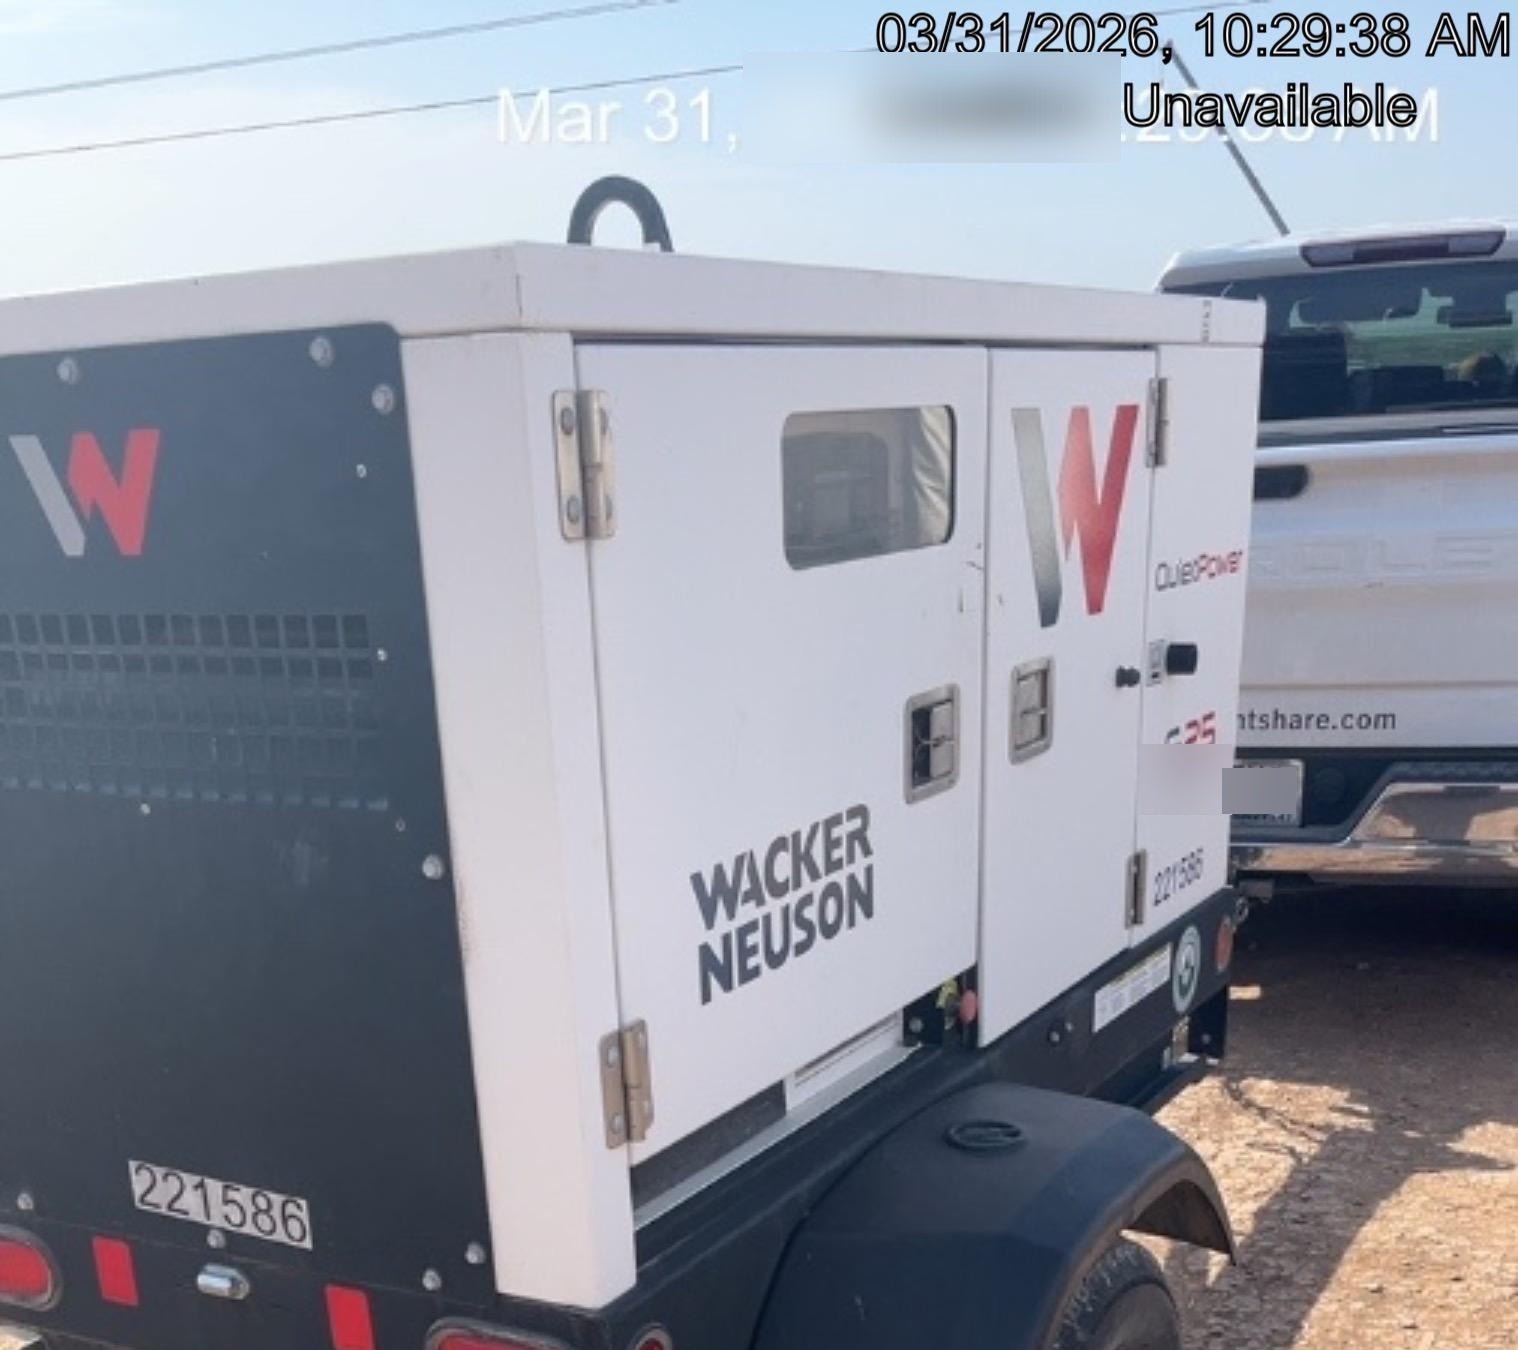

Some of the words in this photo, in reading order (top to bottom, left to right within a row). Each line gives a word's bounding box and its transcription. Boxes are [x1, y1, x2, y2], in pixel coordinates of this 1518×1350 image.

[690, 803, 874, 931] WACKER
[698, 863, 874, 1006] NEUSON
[134, 1162, 307, 1243] 221586
